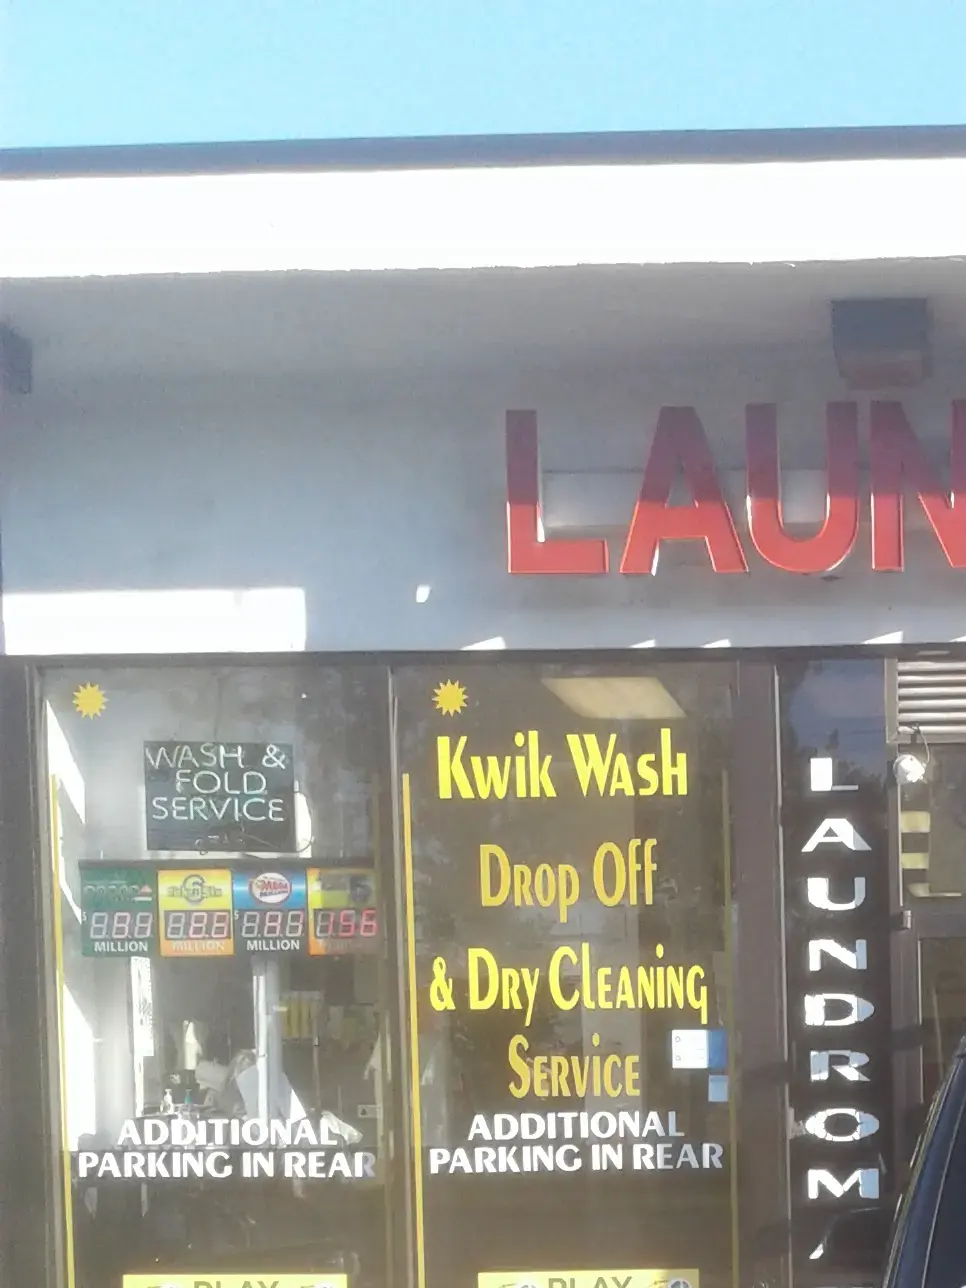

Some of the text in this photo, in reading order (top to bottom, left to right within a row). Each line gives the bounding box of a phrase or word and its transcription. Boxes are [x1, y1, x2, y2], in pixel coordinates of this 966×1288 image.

[145, 742, 286, 770] WASH &
[436, 727, 689, 800] Kwik Wash
[175, 769, 268, 795] FOLD
[152, 797, 284, 822] SERVICE
[480, 838, 658, 924] Drop Off
[94, 940, 149, 953] MILLION
[246, 939, 301, 952] MILLION
[429, 942, 708, 1027] & Dry Cleaning
[508, 1033, 641, 1098] Service
[117, 1118, 339, 1146] ADDITIONAL
[468, 1111, 685, 1141] ADDITIONAL
[78, 1151, 376, 1178] PARKING IN REAR
[429, 1143, 724, 1174] PARKING IN REAR
